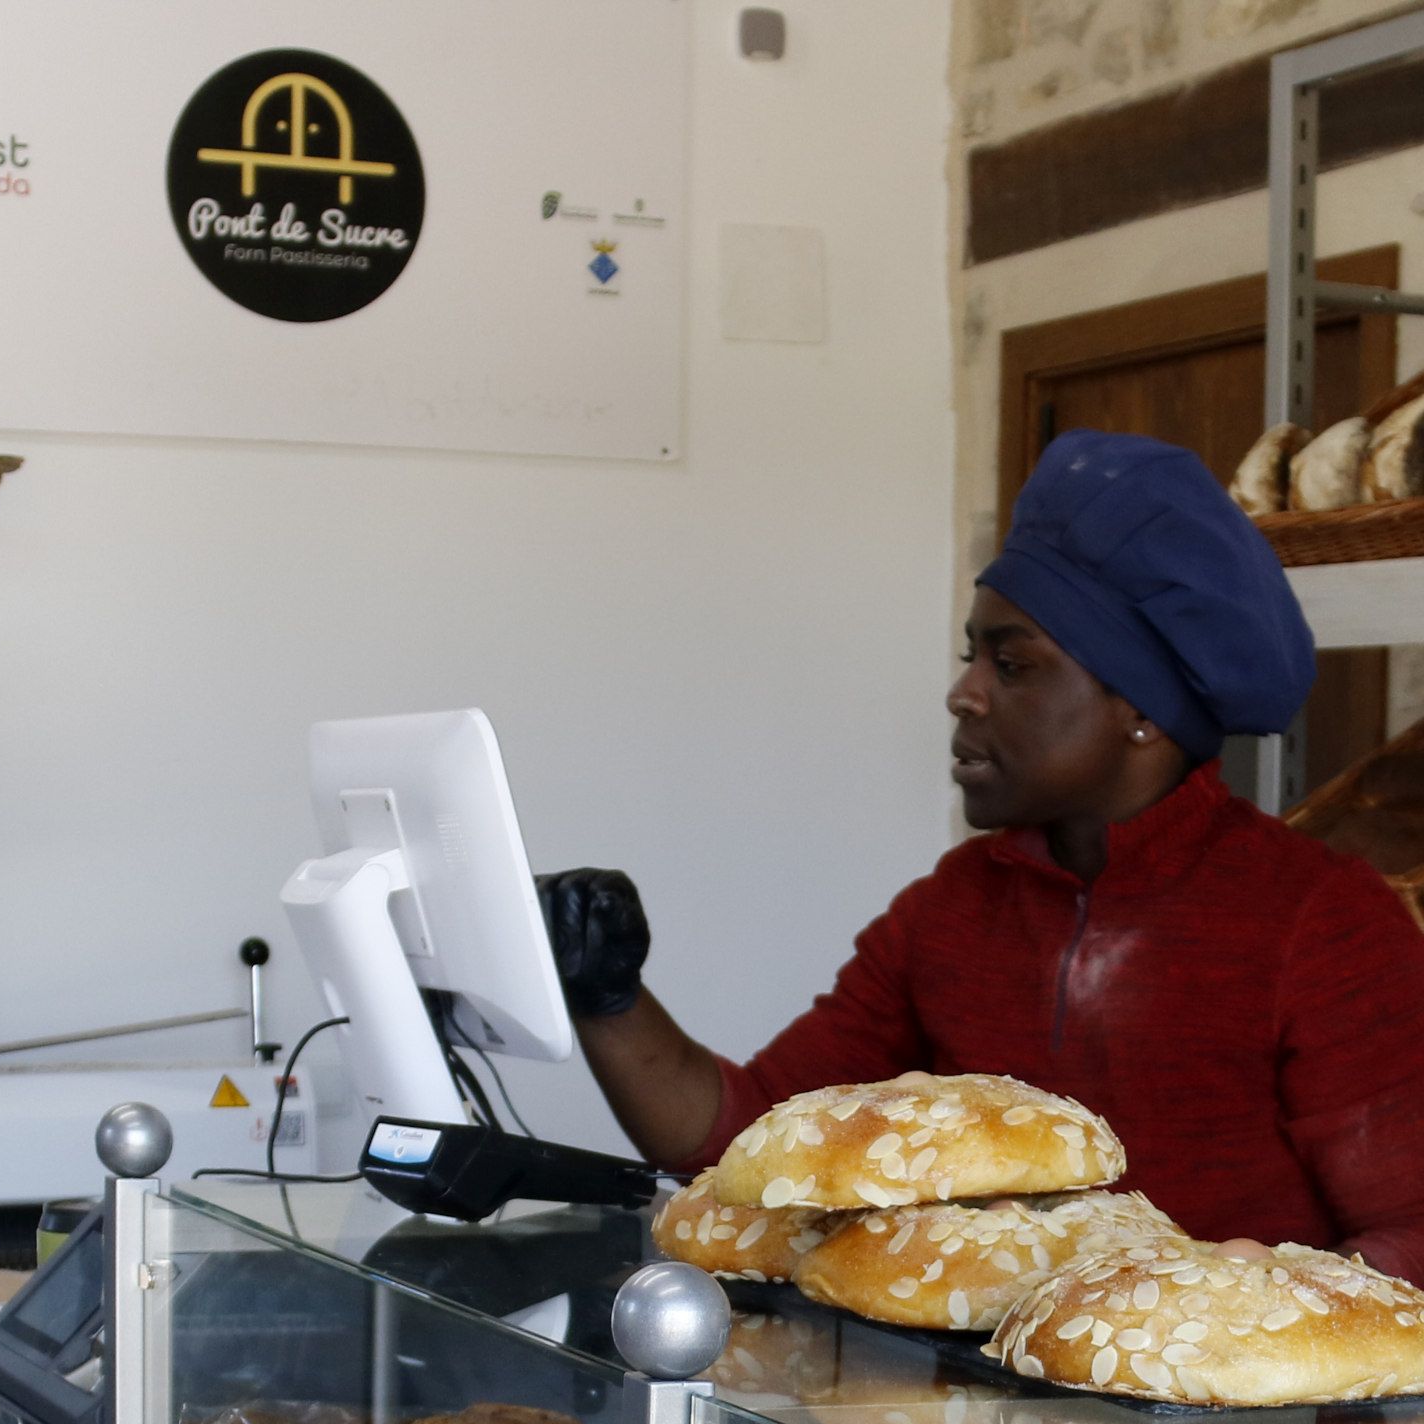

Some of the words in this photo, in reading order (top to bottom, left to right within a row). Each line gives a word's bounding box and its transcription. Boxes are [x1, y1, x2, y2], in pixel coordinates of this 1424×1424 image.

[188, 198, 266, 240] Pont
[271, 202, 311, 241] de
[317, 208, 410, 250] Sucre
[224, 243, 267, 263] Forn
[270, 247, 370, 270] Pastisseria
